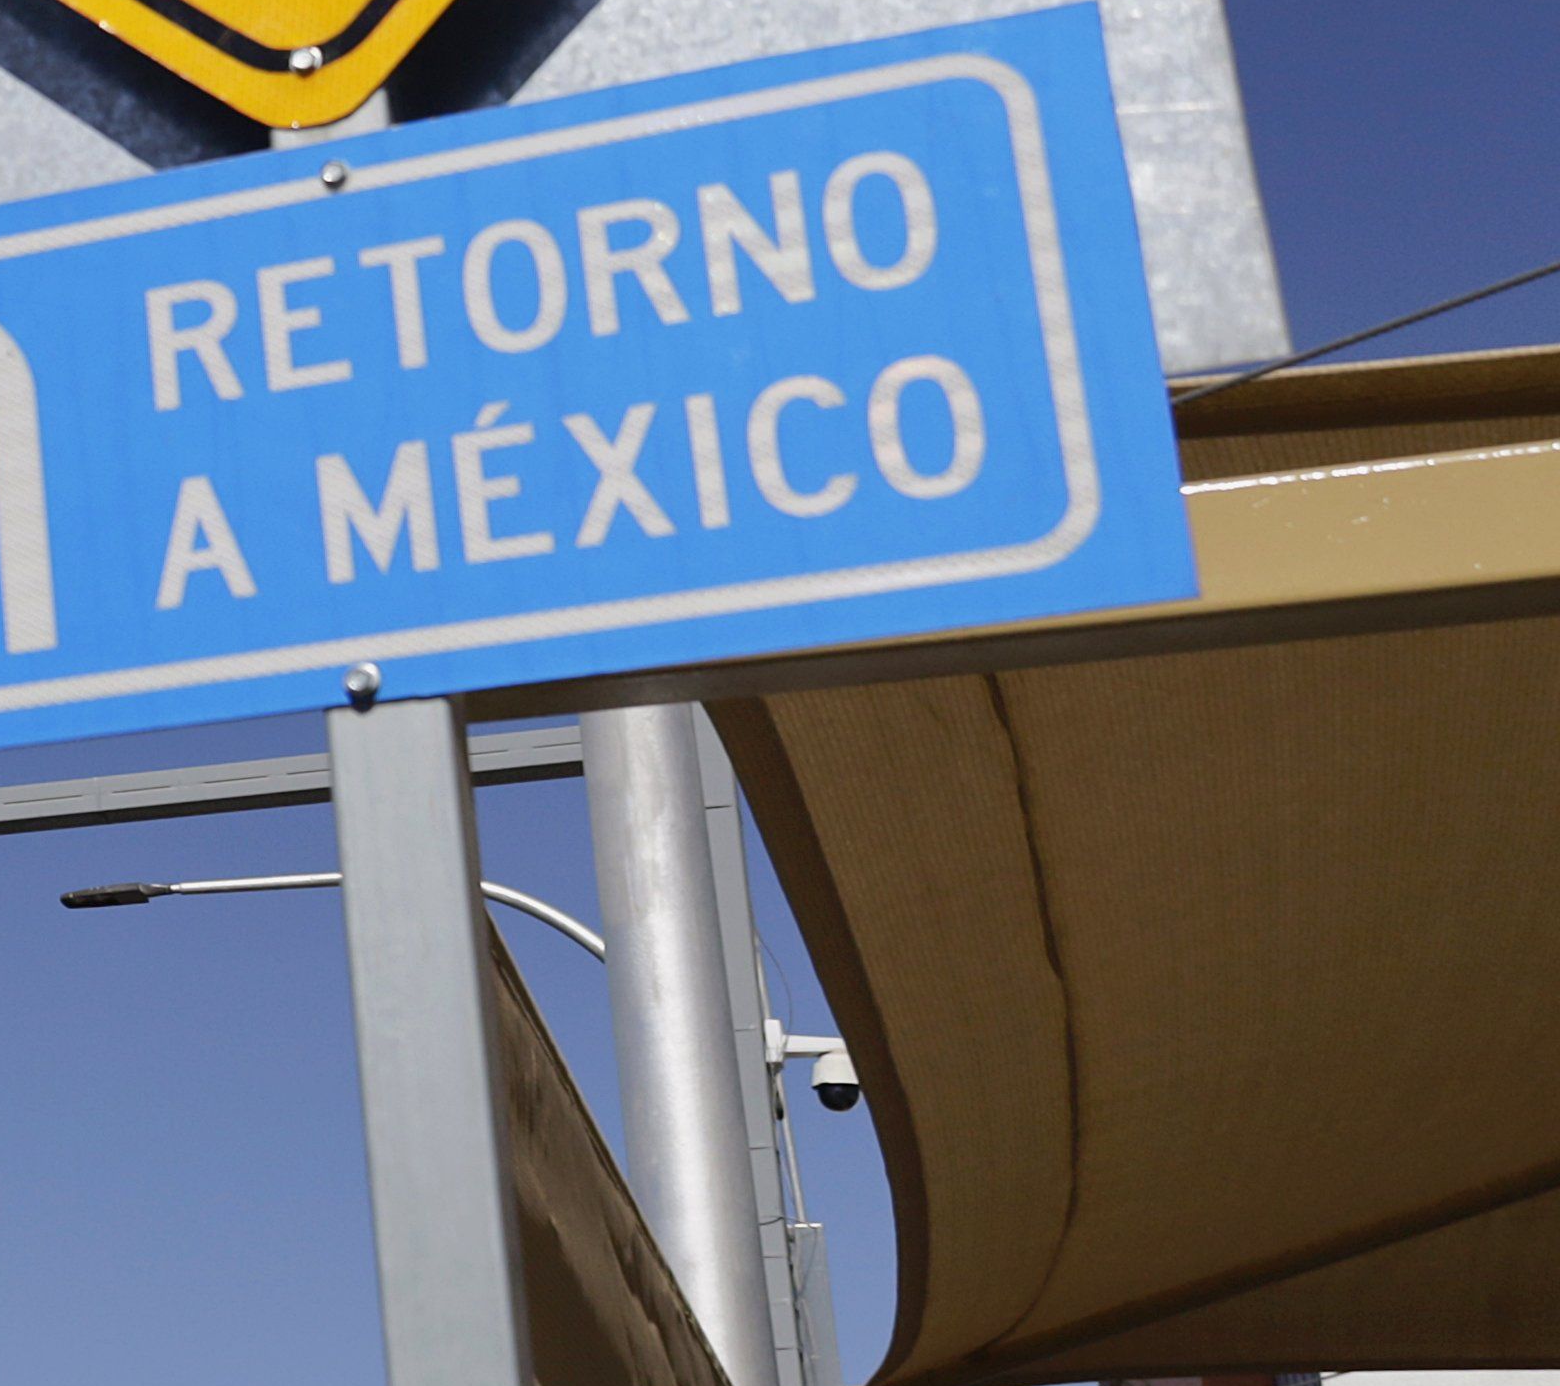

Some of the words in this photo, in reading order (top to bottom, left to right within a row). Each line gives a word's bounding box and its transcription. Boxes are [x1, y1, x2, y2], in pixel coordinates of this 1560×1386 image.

[143, 149, 939, 413] RETORNO
[155, 474, 258, 611] A
[314, 353, 988, 585] MÉXICO
